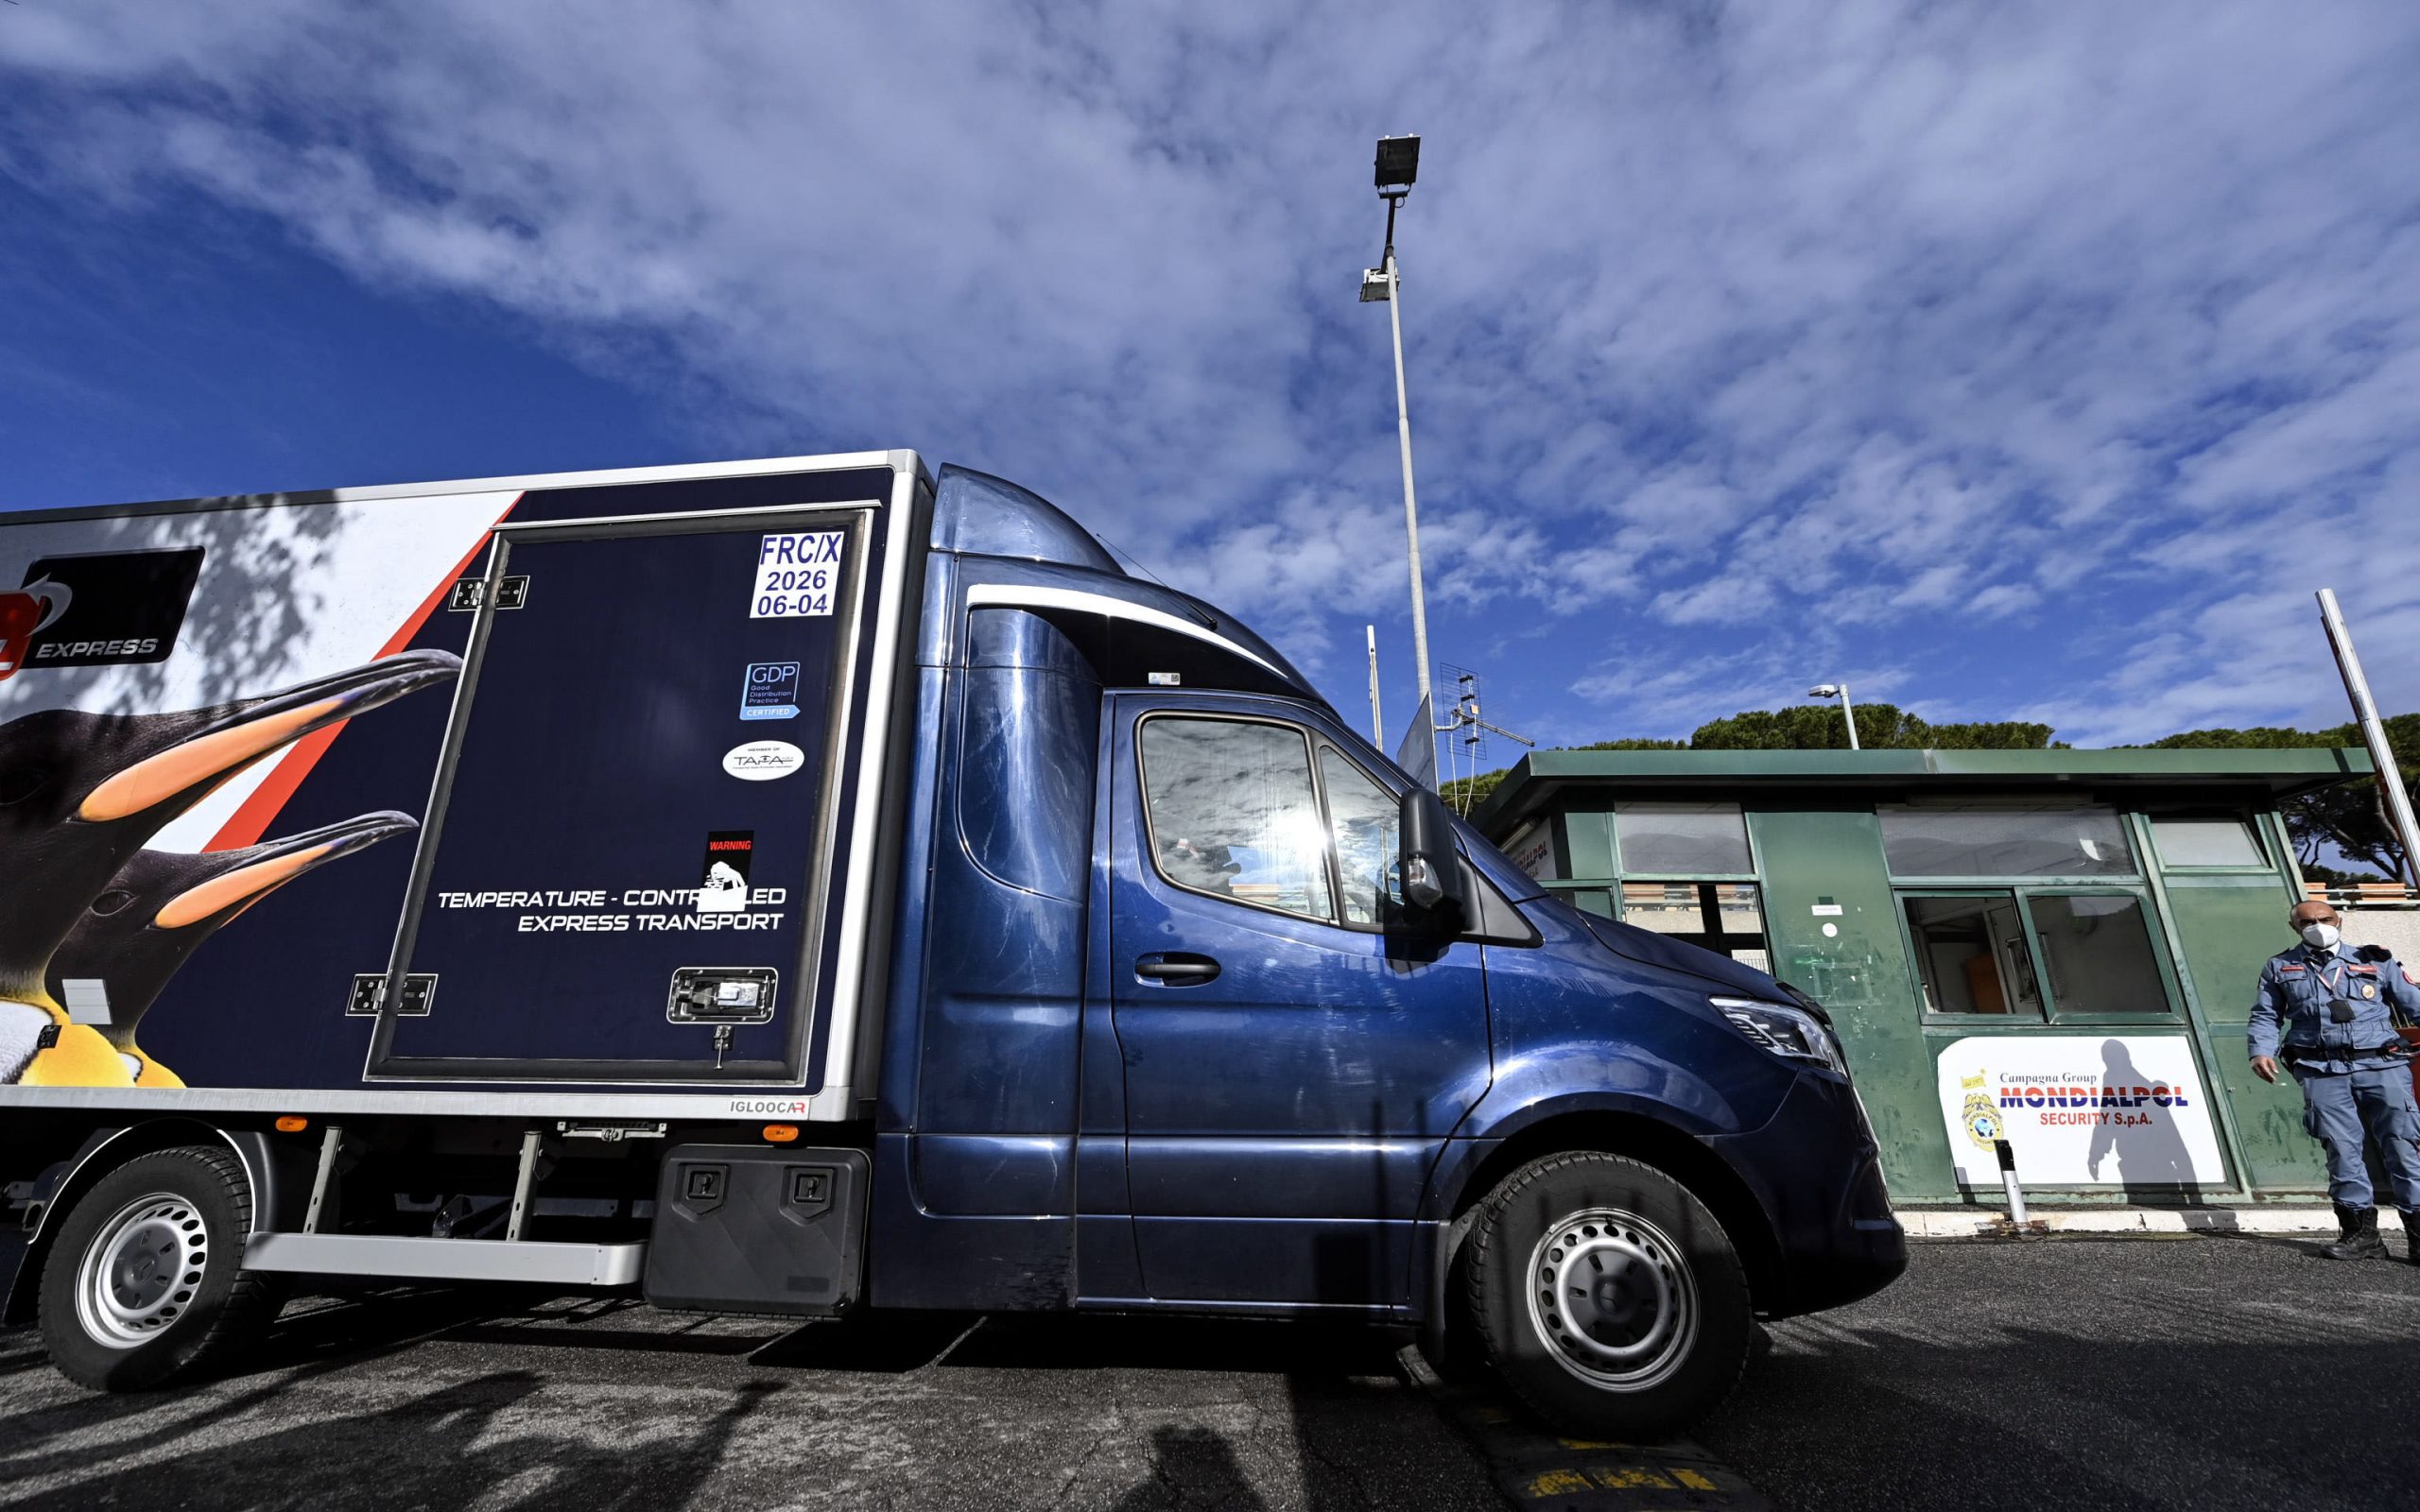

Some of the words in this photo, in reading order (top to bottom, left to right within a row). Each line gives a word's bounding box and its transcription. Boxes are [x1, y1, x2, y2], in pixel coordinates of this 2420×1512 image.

[760, 534, 841, 565] FRC/X
[765, 570, 827, 592] 2026
[757, 593, 828, 616] 06-04
[35, 639, 159, 659] EXPRESS
[752, 665, 796, 683] GDP
[710, 840, 752, 850] WARNING
[438, 891, 607, 908] TEMPERATURE
[623, 888, 786, 906] CONTRED
[518, 915, 631, 932] EXPRESS
[636, 913, 785, 931] TRANSPORT
[1999, 1073, 2059, 1085] Campagna
[2062, 1073, 2097, 1085] Group
[730, 1101, 805, 1113] IGLOOCAR
[2000, 1087, 2188, 1108] MONDIALPOL
[2040, 1112, 2109, 1125] SECURITY
[2114, 1112, 2152, 1127] S.p.A.
